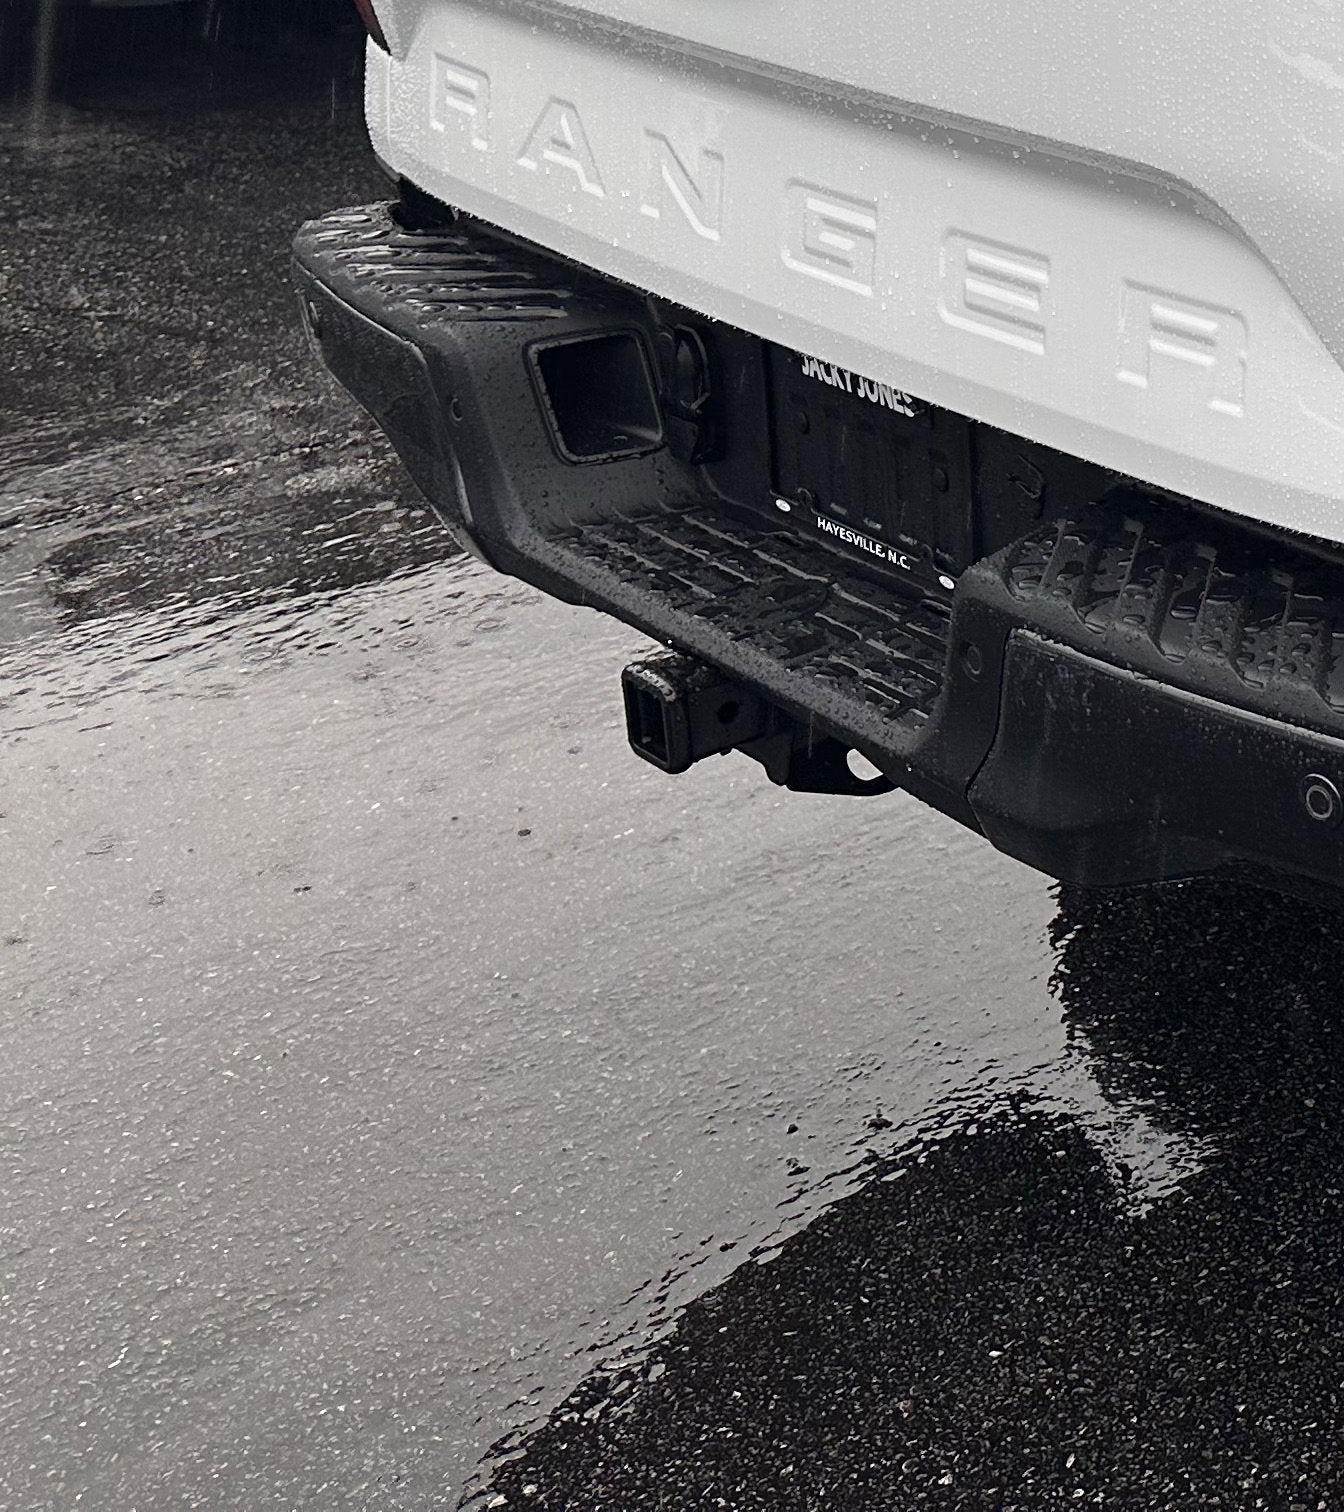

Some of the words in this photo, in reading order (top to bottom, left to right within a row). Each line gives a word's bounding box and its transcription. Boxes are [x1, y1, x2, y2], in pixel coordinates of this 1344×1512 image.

[430, 51, 1250, 418] RANGER
[801, 354, 852, 393] JACKY
[857, 376, 915, 418] JONES
[887, 550, 911, 570] N.C.
